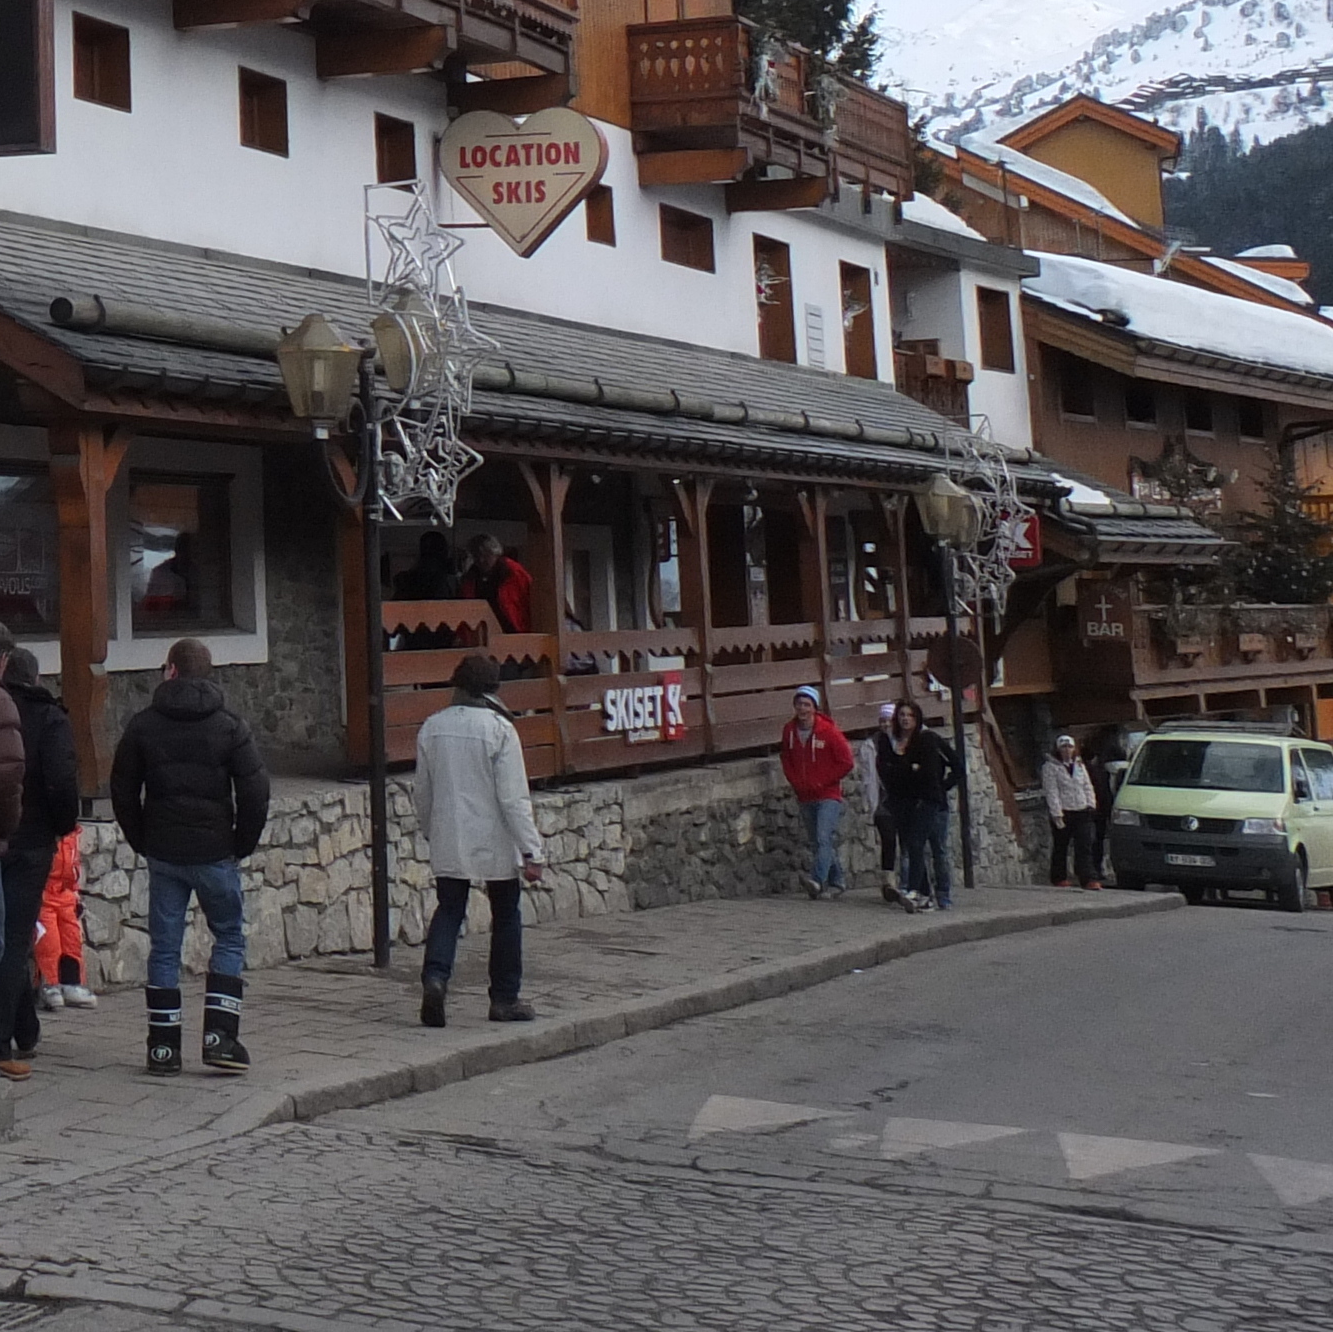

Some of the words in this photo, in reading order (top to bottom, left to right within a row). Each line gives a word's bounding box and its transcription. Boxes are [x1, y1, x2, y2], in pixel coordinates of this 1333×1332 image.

[459, 141, 581, 169] LOCATION
[492, 180, 547, 205] SKIS
[1086, 621, 1124, 636] BAR
[605, 685, 663, 731] SKISET
